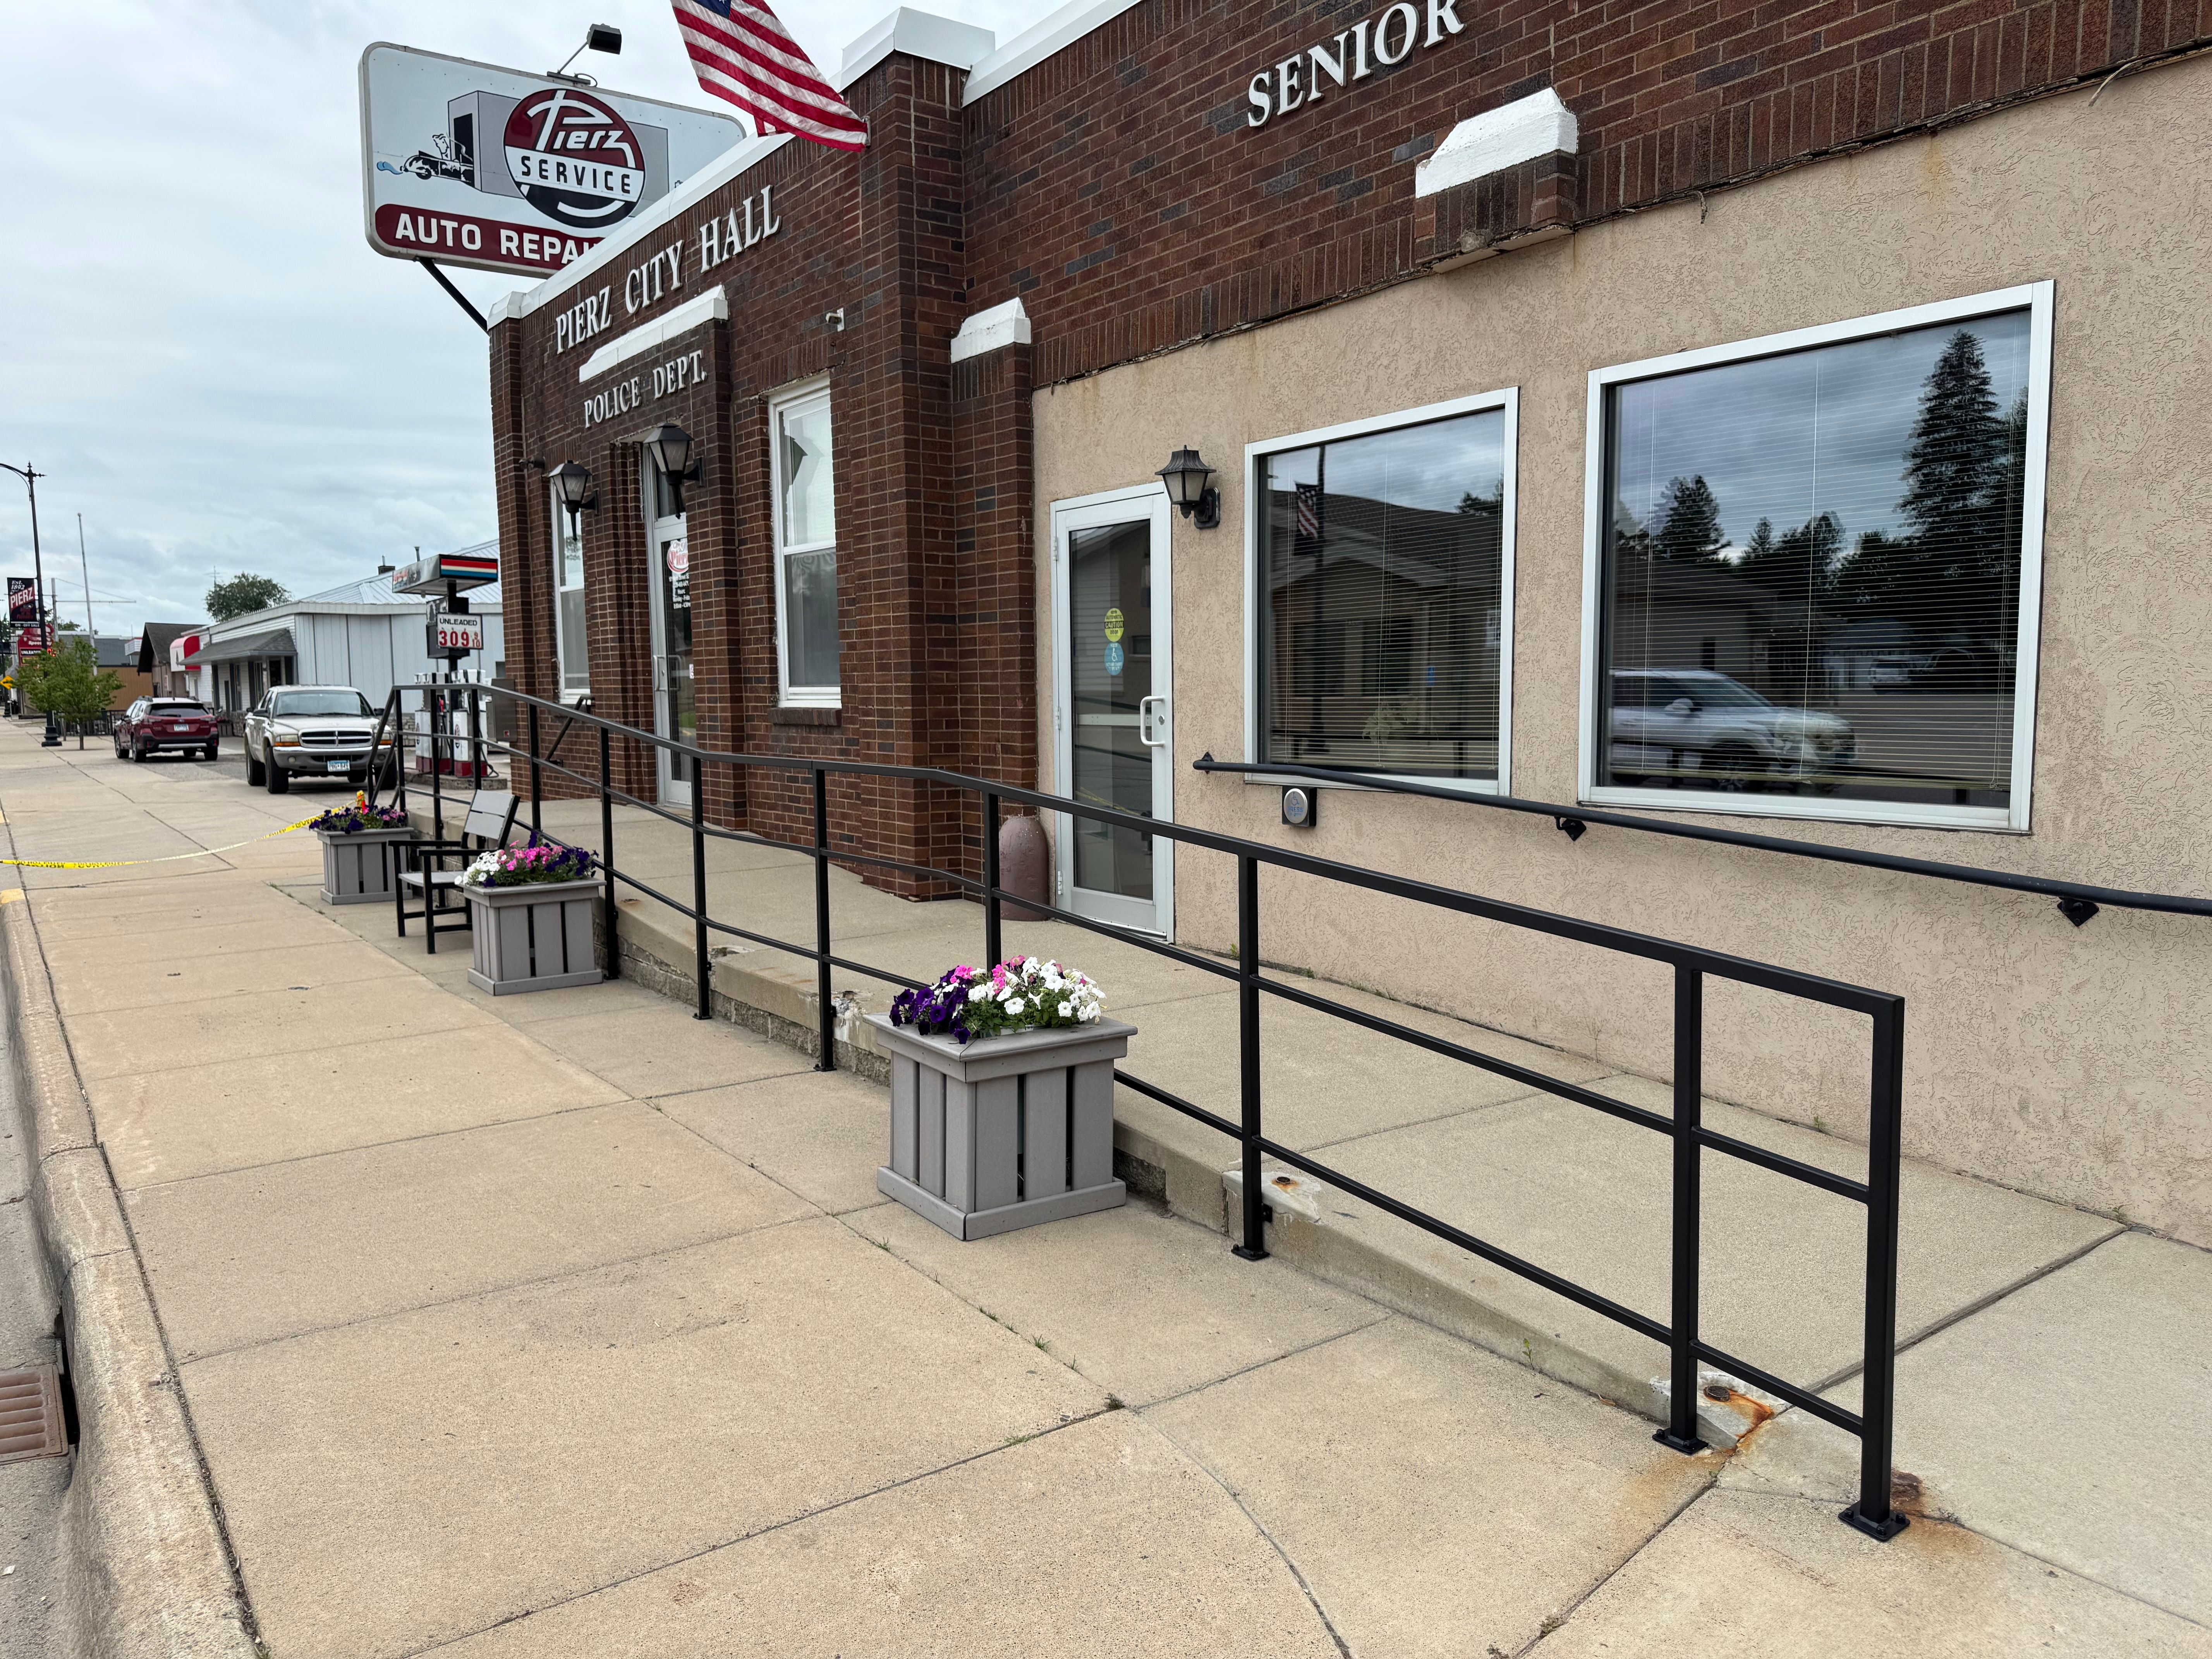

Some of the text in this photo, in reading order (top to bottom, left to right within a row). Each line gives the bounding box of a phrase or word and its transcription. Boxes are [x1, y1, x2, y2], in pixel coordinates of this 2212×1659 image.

[1248, 0, 1467, 127] SENIOR
[527, 90, 635, 168] Pierz
[521, 156, 630, 194] SERVICE
[395, 213, 597, 264] AUTO REPA
[556, 185, 782, 354] PIERZ CITY HALL
[584, 350, 708, 428] POLICE DEPT.
[10, 587, 33, 608] PIERZ
[439, 630, 469, 647] 309
[440, 618, 477, 626] UNLEADED
[472, 639, 480, 648] 10
